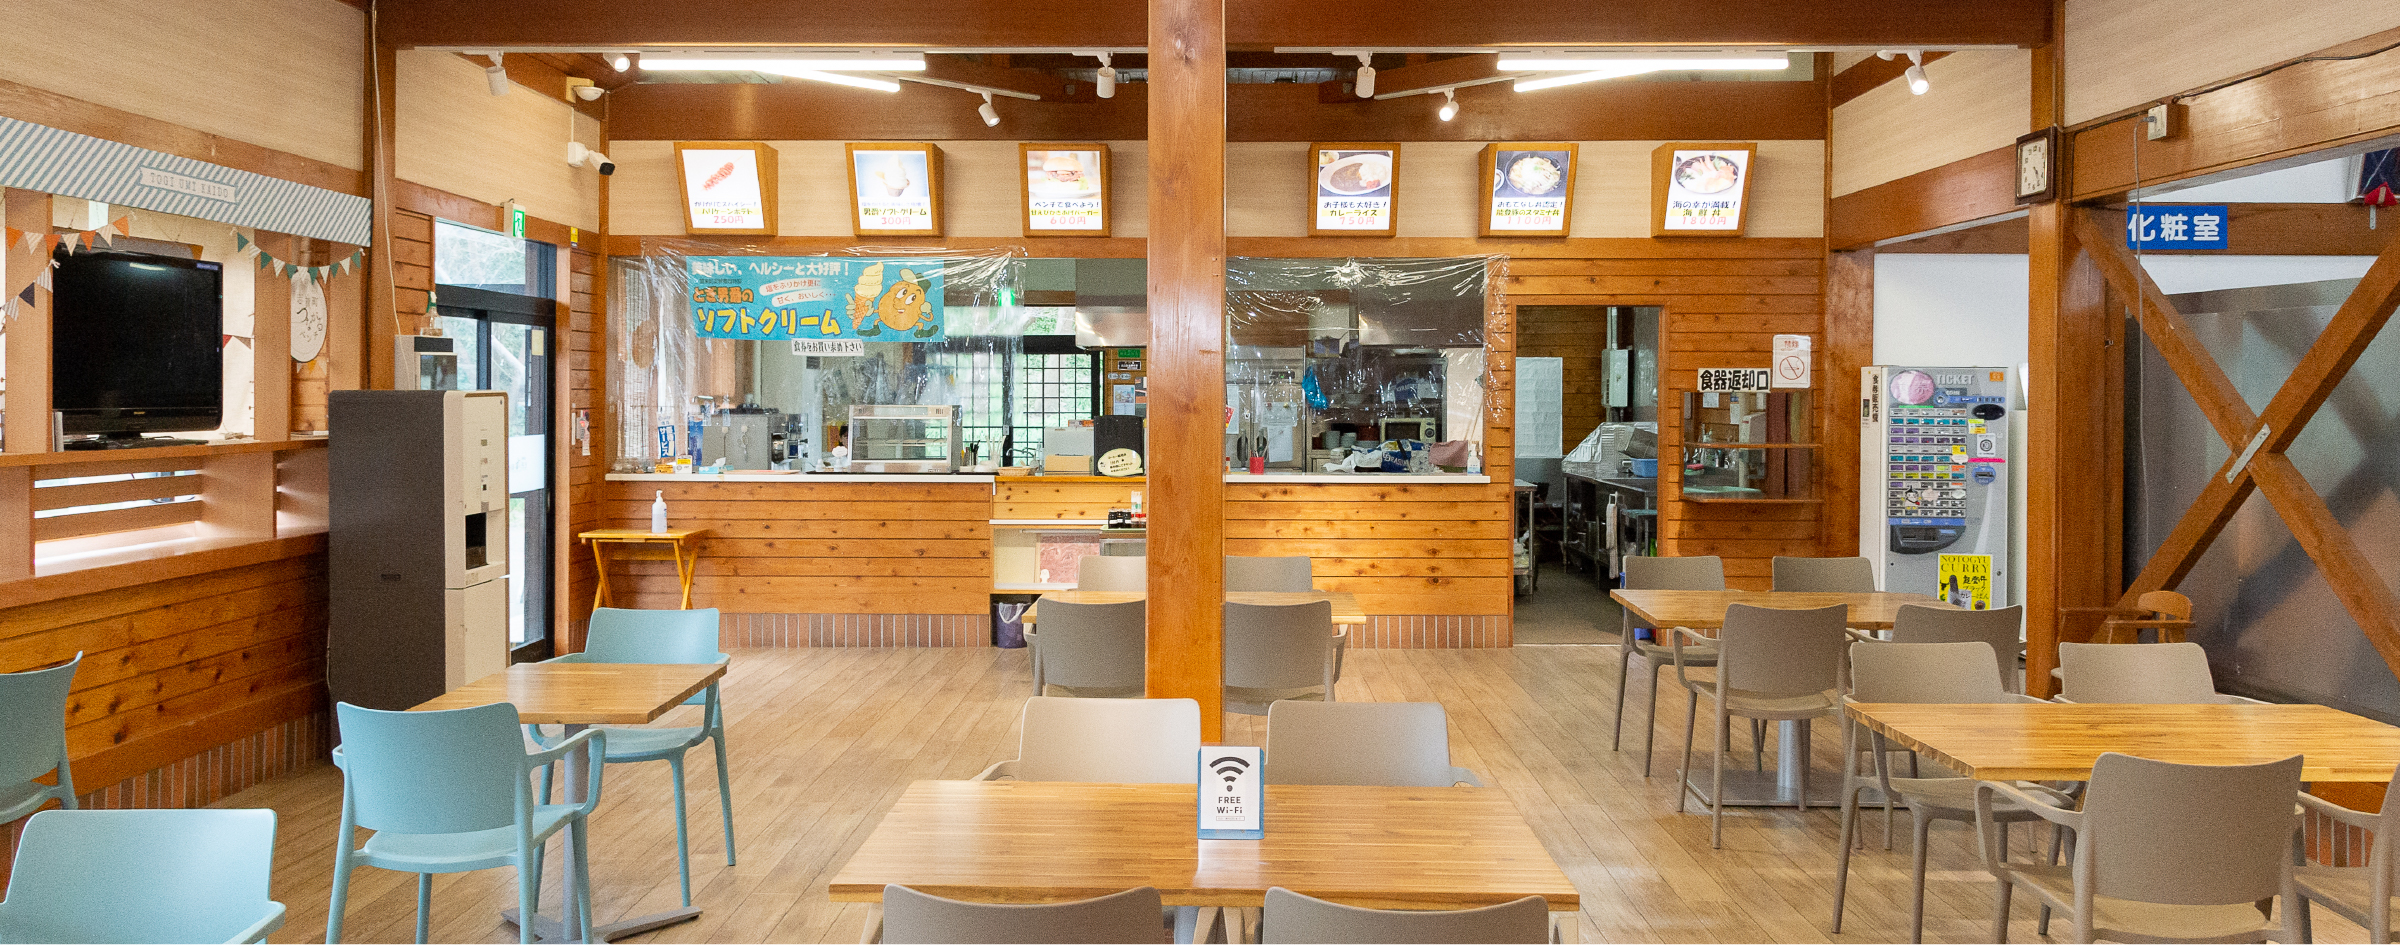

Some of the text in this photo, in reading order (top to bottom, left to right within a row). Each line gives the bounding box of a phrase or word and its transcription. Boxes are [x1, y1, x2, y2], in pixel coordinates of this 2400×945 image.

[150, 172, 229, 198] TOGI UMI KAIDO
[1673, 201, 1737, 209] 海の幸が満載！
[863, 208, 927, 216] 男爵ソフトクリーム
[1330, 209, 1378, 217] カレーライス
[713, 215, 744, 224] 250円
[881, 216, 911, 225] 300円
[1050, 216, 1086, 225] 600円
[1339, 216, 1375, 225] 750円
[1507, 216, 1552, 225] 1100円
[1682, 216, 1727, 225] 1800円
[2127, 212, 2220, 242] 化粧室
[765, 279, 821, 293] 塩をふりかけ更に
[692, 285, 754, 304] とぎ男爵の
[696, 306, 842, 336] ソフトクリーム
[794, 340, 862, 353] 食券をお買い求め下さい
[1699, 369, 1769, 391] 食器返却口
[1935, 374, 1974, 385] TICKET
[1940, 563, 1989, 573] CURRY
[1218, 796, 1241, 804] FREE
[1216, 806, 1243, 814] Wi-Fi
